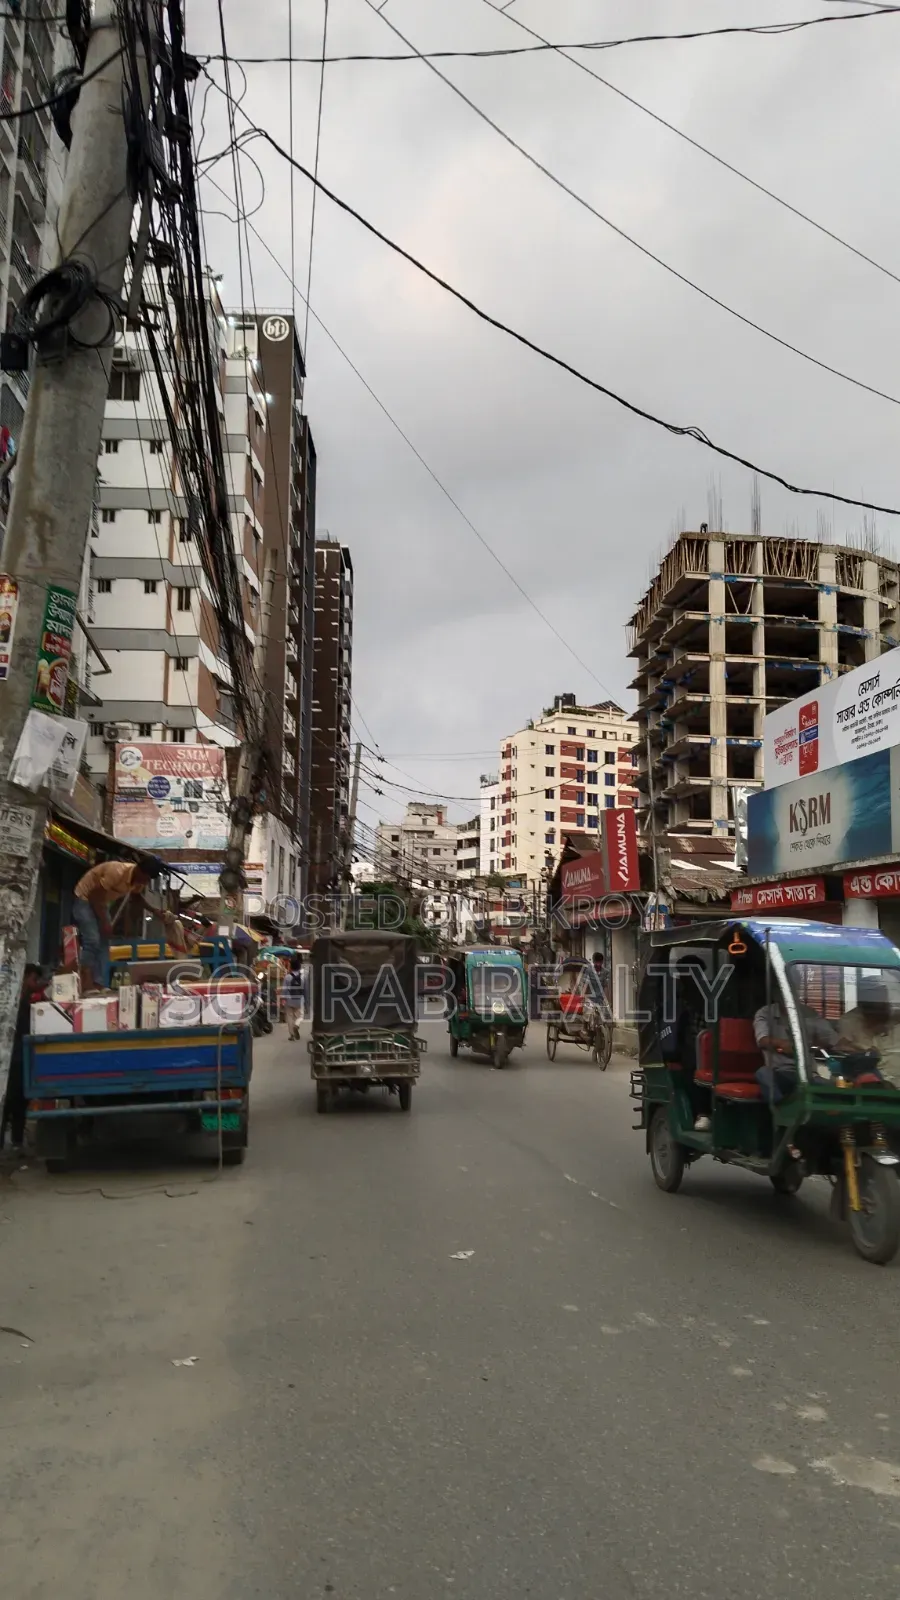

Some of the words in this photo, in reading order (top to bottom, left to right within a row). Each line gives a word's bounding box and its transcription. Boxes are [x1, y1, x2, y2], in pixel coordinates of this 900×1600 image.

[858, 669, 881, 697] মেসার্স
[836, 704, 856, 724] সাত্তার
[176, 749, 209, 760] SMM
[789, 791, 831, 836] KSRM
[616, 812, 629, 875] JAMUNA
[756, 884, 783, 905] মেসার্স
[786, 883, 818, 903] সাত্তার
